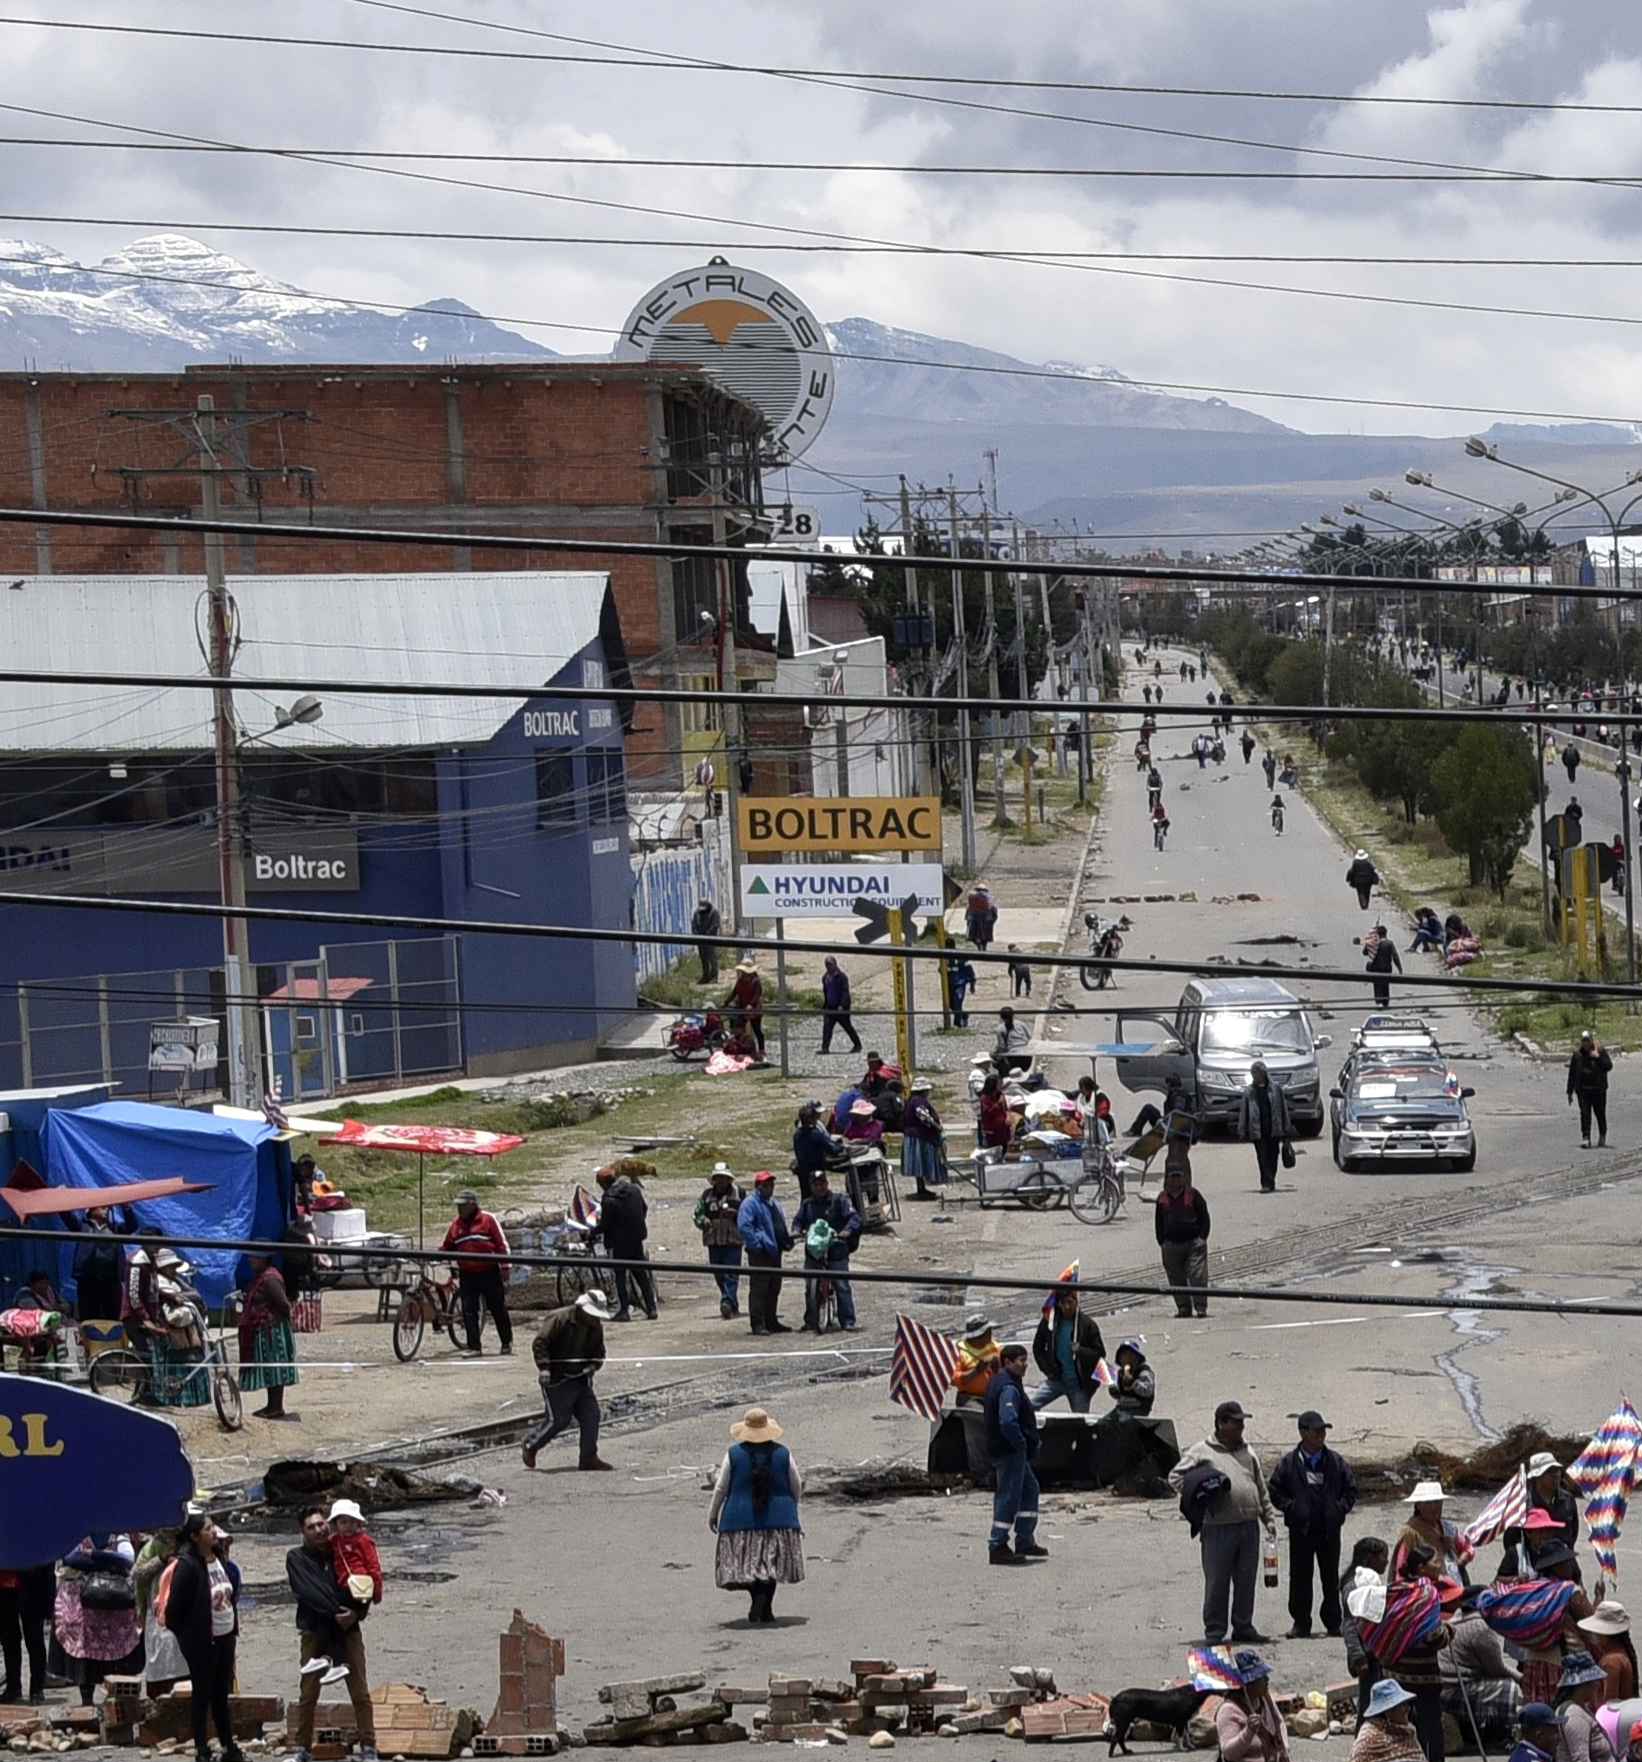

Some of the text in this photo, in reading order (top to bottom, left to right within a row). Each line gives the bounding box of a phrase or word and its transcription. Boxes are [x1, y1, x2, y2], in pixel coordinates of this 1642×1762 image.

[629, 273, 819, 350] METALES
[524, 711, 580, 736] BOLTRAC
[751, 807, 934, 841] BOLTRAC
[256, 855, 347, 880] Boltrac
[775, 875, 891, 894] HYUNDAI
